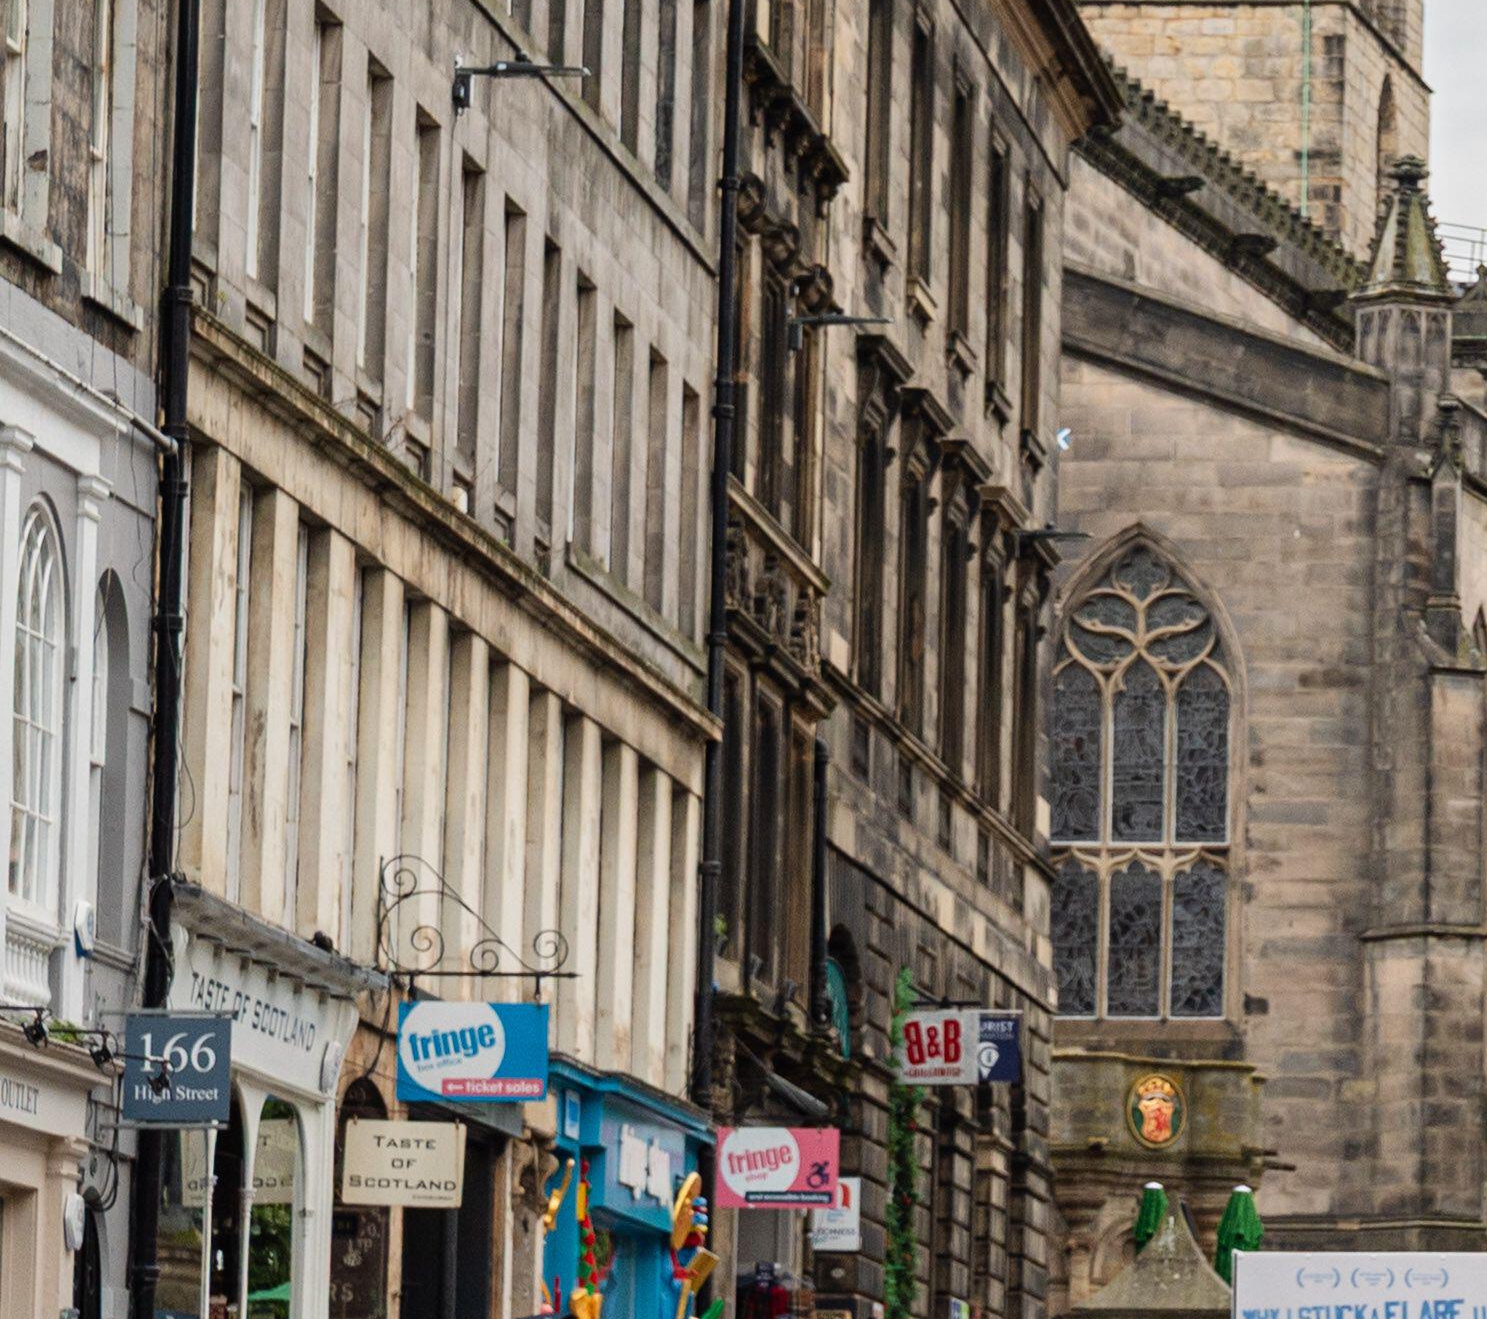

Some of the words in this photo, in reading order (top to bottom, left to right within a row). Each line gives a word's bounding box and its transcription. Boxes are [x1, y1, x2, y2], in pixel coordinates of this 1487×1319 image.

[191, 972, 230, 1012] TASTE
[233, 991, 251, 1022] OF
[252, 1000, 316, 1052] SCOTLAND
[140, 1032, 216, 1073] 166
[409, 1024, 496, 1061] fringe
[1, 1080, 39, 1116] OUTLET
[176, 1085, 219, 1101] Street
[466, 1079, 502, 1092] ticket
[505, 1081, 540, 1093] sales
[728, 1144, 793, 1175] fringe
